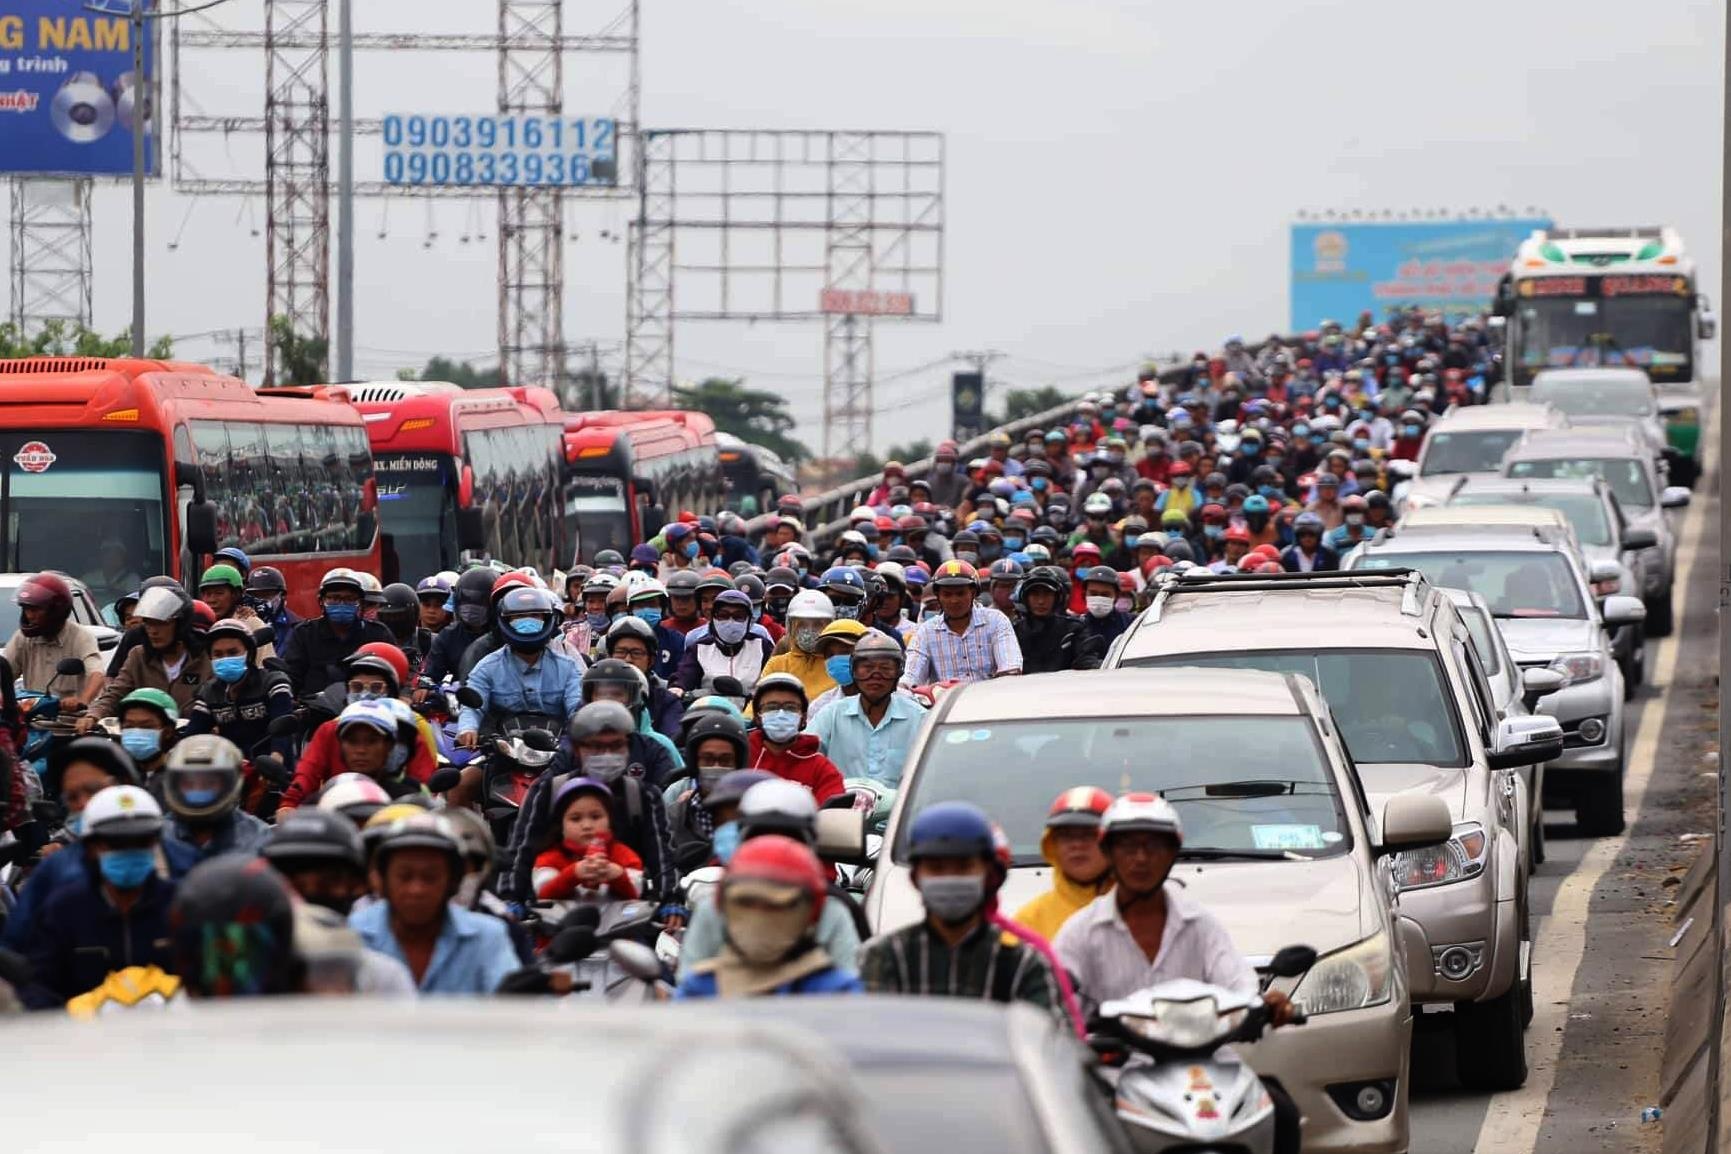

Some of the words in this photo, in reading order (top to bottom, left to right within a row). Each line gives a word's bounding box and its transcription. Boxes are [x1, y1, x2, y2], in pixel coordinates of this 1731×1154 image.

[39, 16, 129, 51] NAM
[383, 115, 612, 148] 0903916112
[384, 152, 611, 186] 090833936
